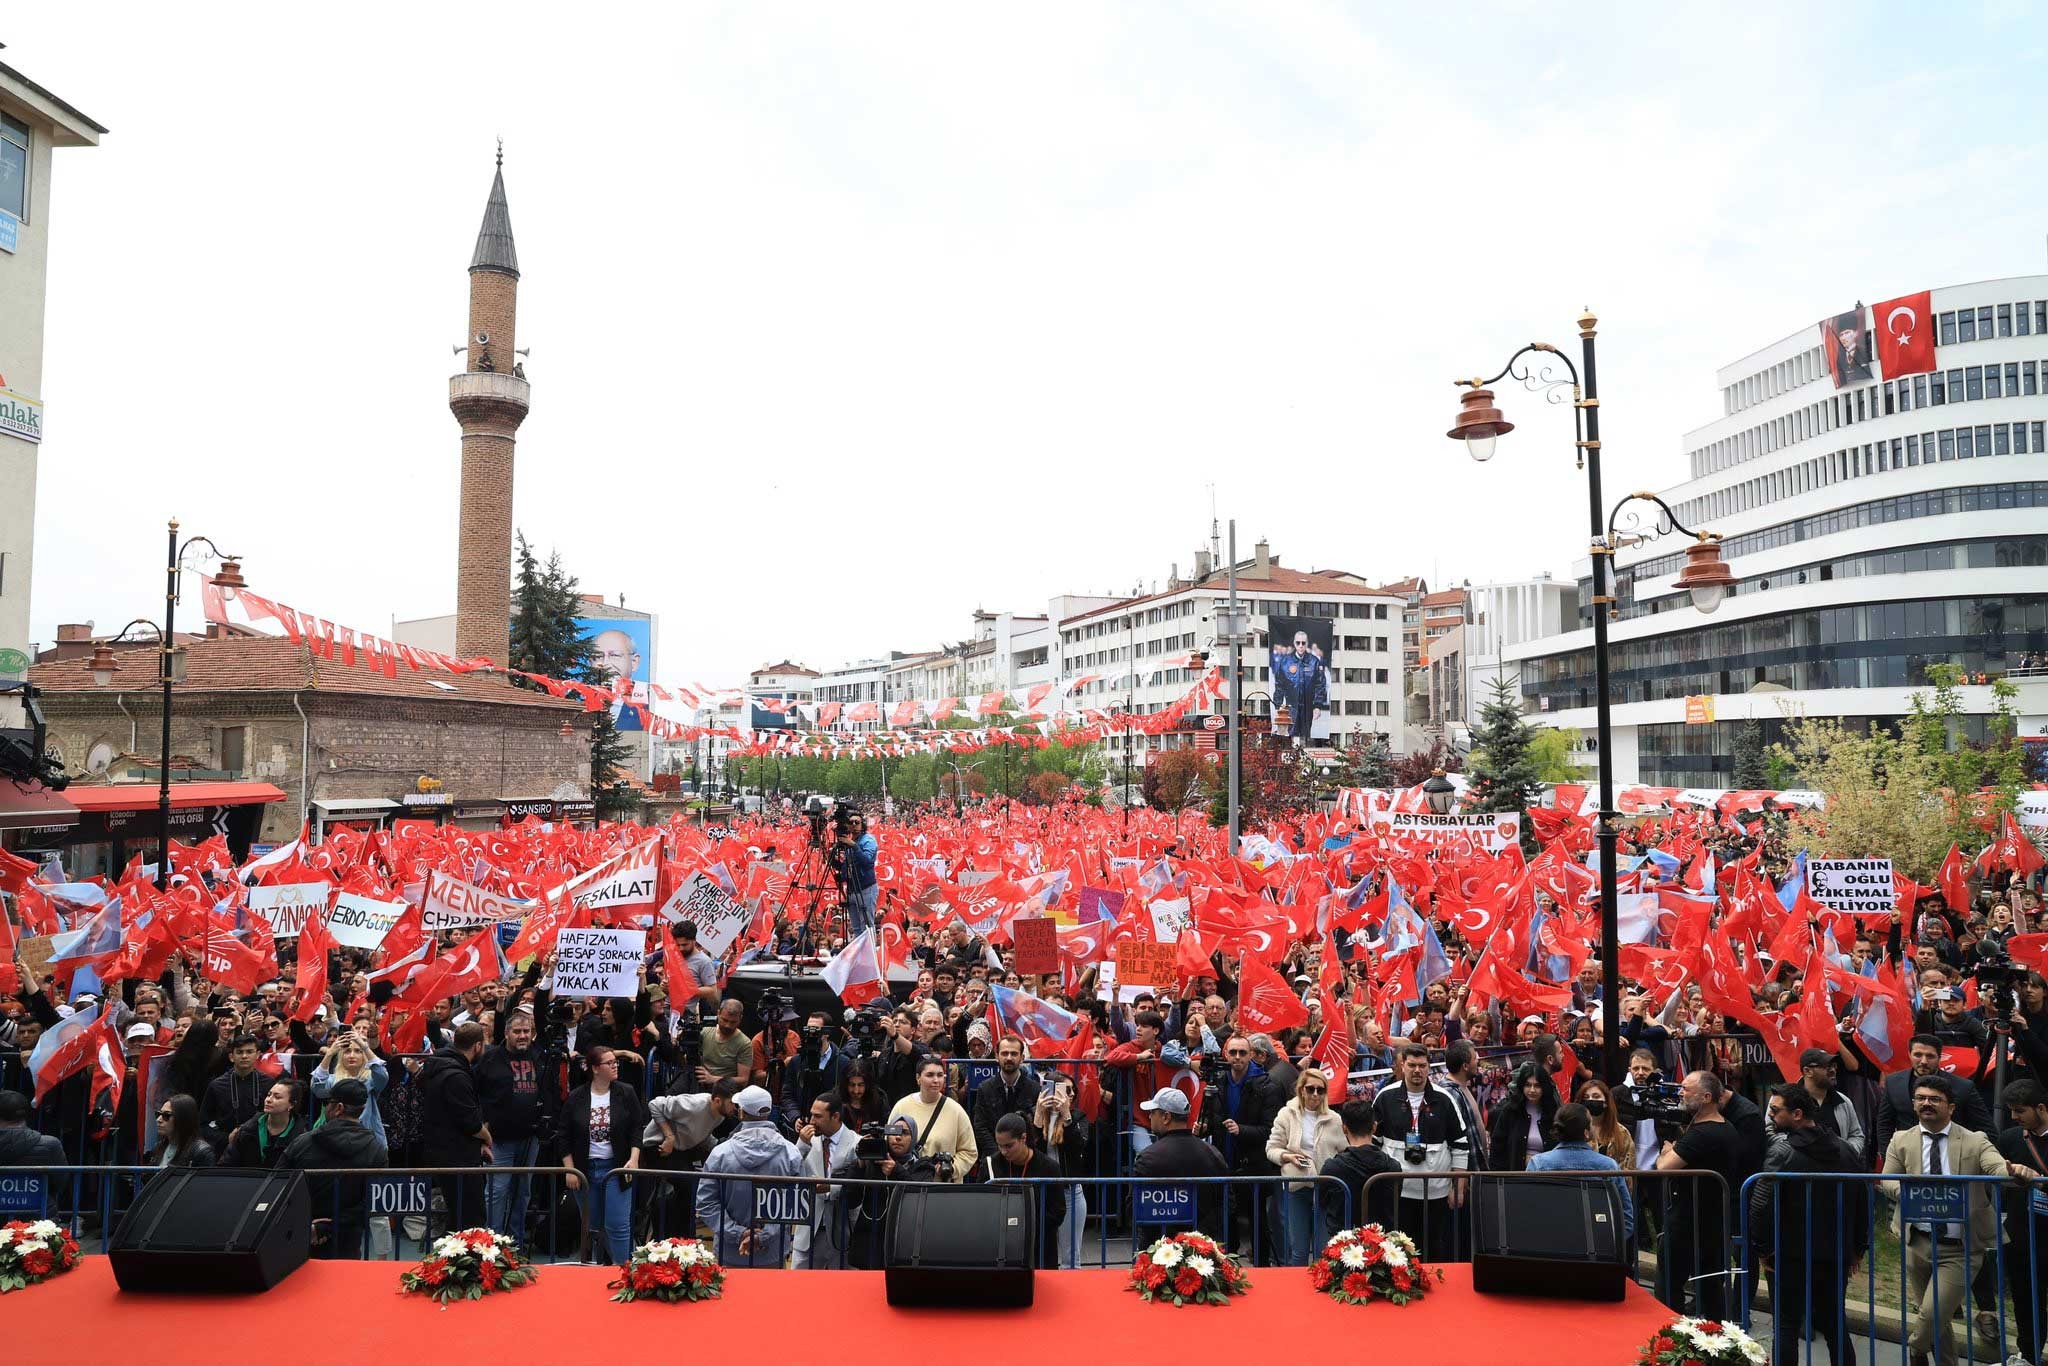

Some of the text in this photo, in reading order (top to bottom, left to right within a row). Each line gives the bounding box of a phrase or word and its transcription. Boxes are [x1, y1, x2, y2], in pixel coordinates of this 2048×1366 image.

[1393, 814, 1496, 826] ASTSUBAYLAR
[1811, 862, 1889, 870] BABANIN
[1844, 872, 1890, 884] OĞLU
[969, 897, 998, 915] CHP
[560, 933, 618, 946] HAFIZAM
[558, 947, 642, 960] HESAP SORACAK
[208, 953, 232, 972] HP
[597, 962, 622, 973] SENİ
[556, 975, 609, 990] YIKACAK
[1746, 1043, 1776, 1064] POL
[974, 1067, 1000, 1078] POL
[0, 1176, 39, 1193] OLİS
[370, 1175, 426, 1212] POLİS
[755, 1184, 810, 1220] POLİS
[1152, 1208, 1178, 1216] BOLU
